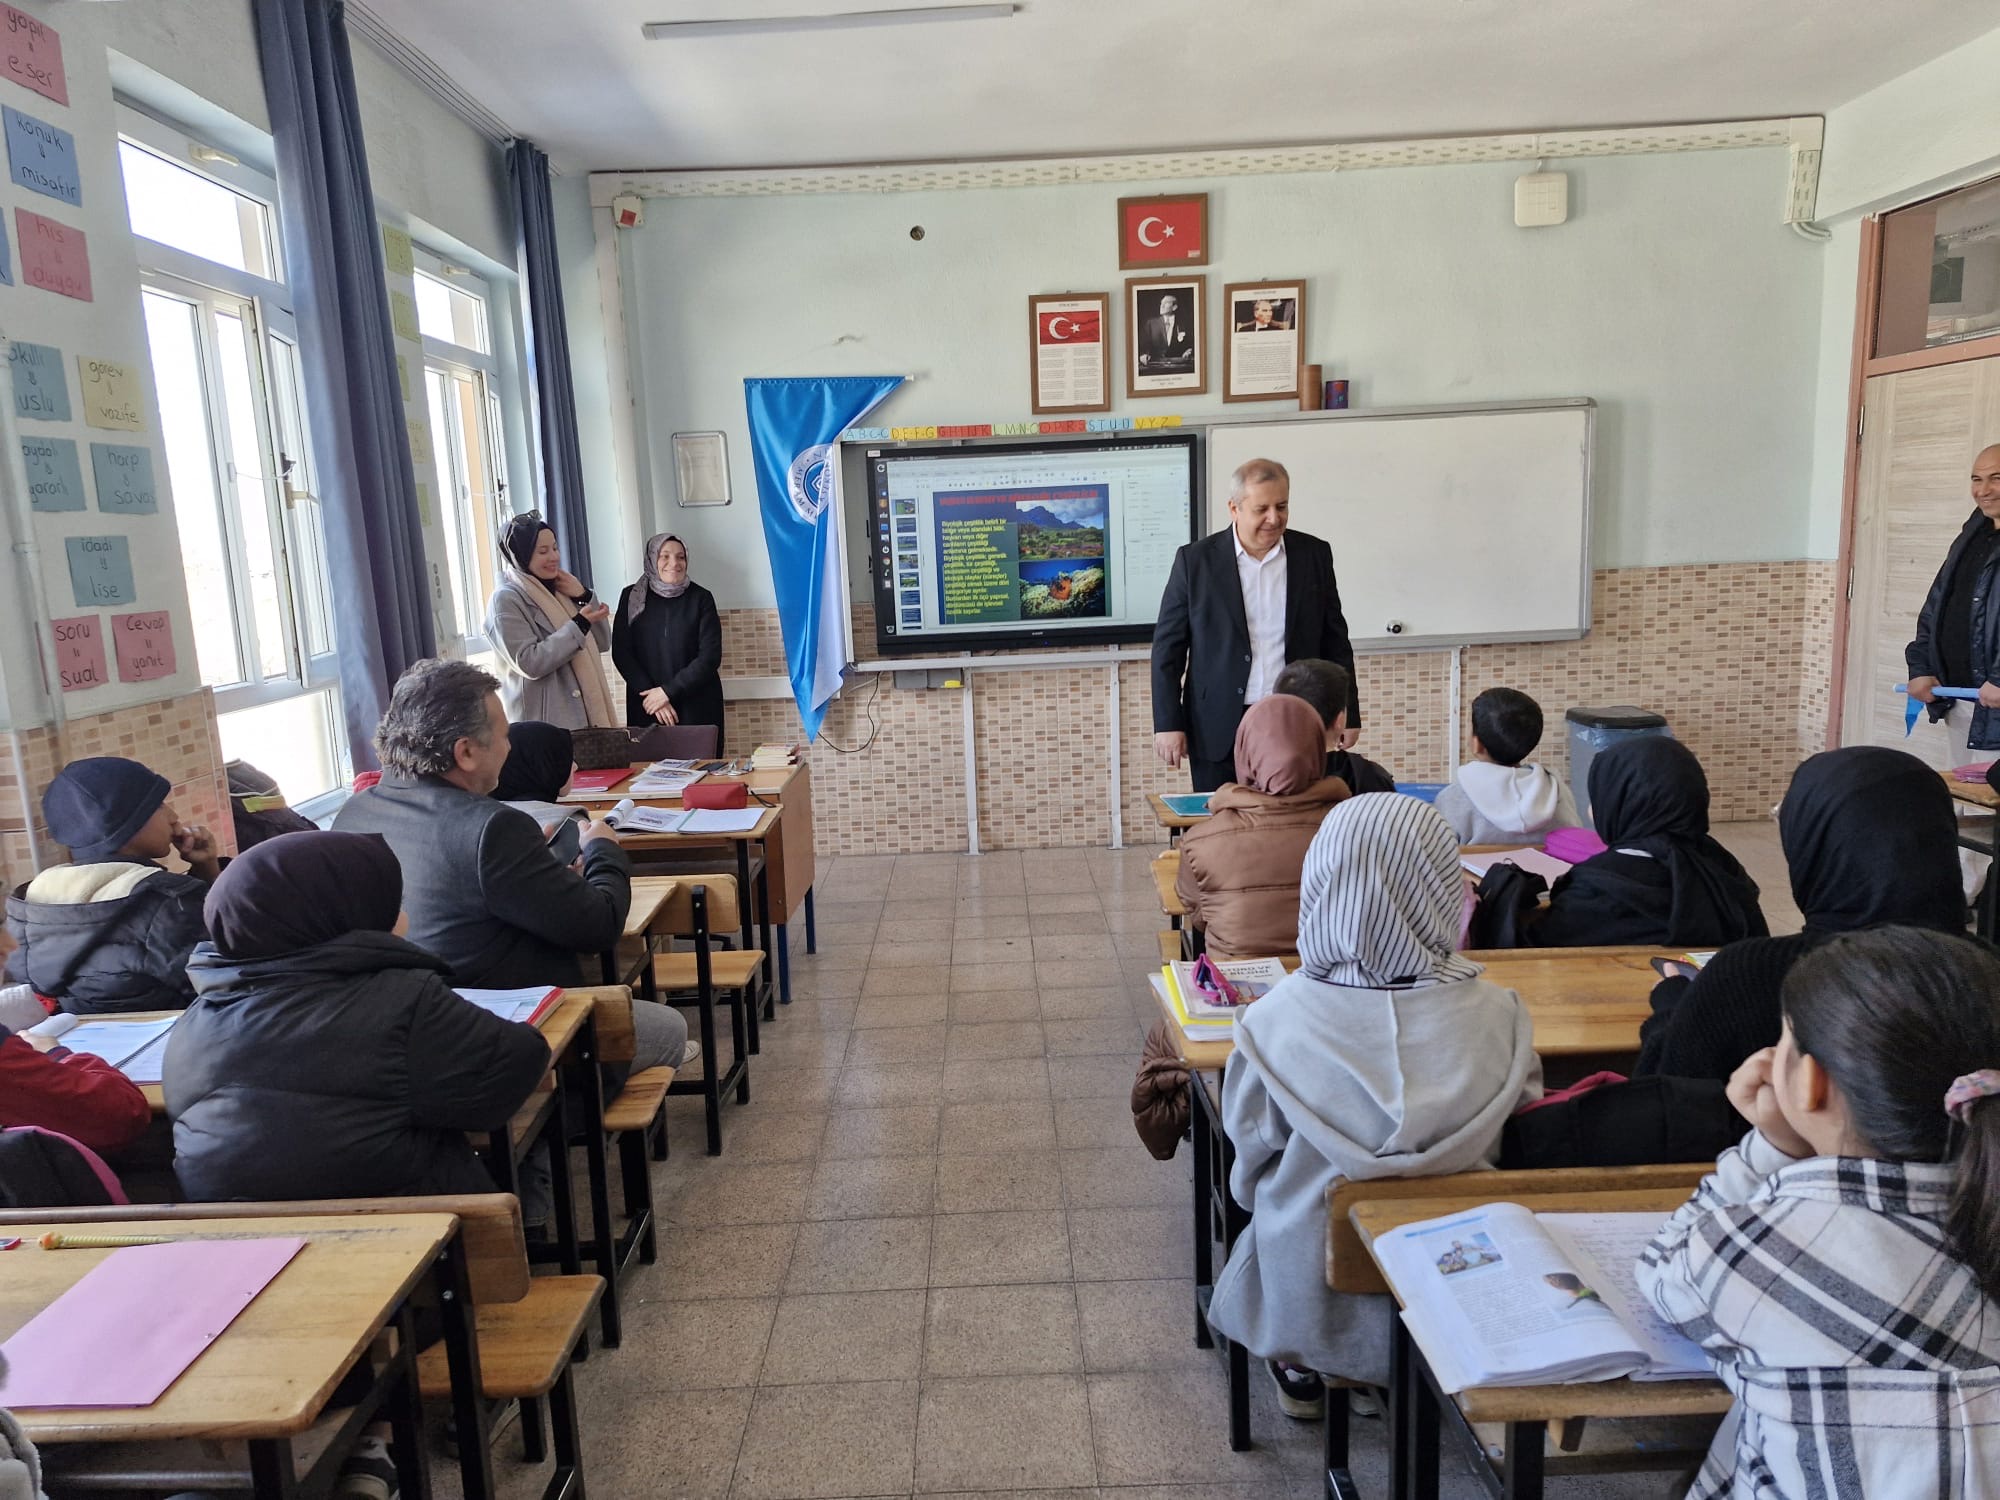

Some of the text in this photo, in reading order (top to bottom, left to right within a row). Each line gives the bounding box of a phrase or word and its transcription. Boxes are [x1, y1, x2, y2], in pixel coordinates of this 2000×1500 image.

[16, 112, 64, 153] konuk
[22, 166, 77, 199] misafir
[89, 575, 121, 598] lise
